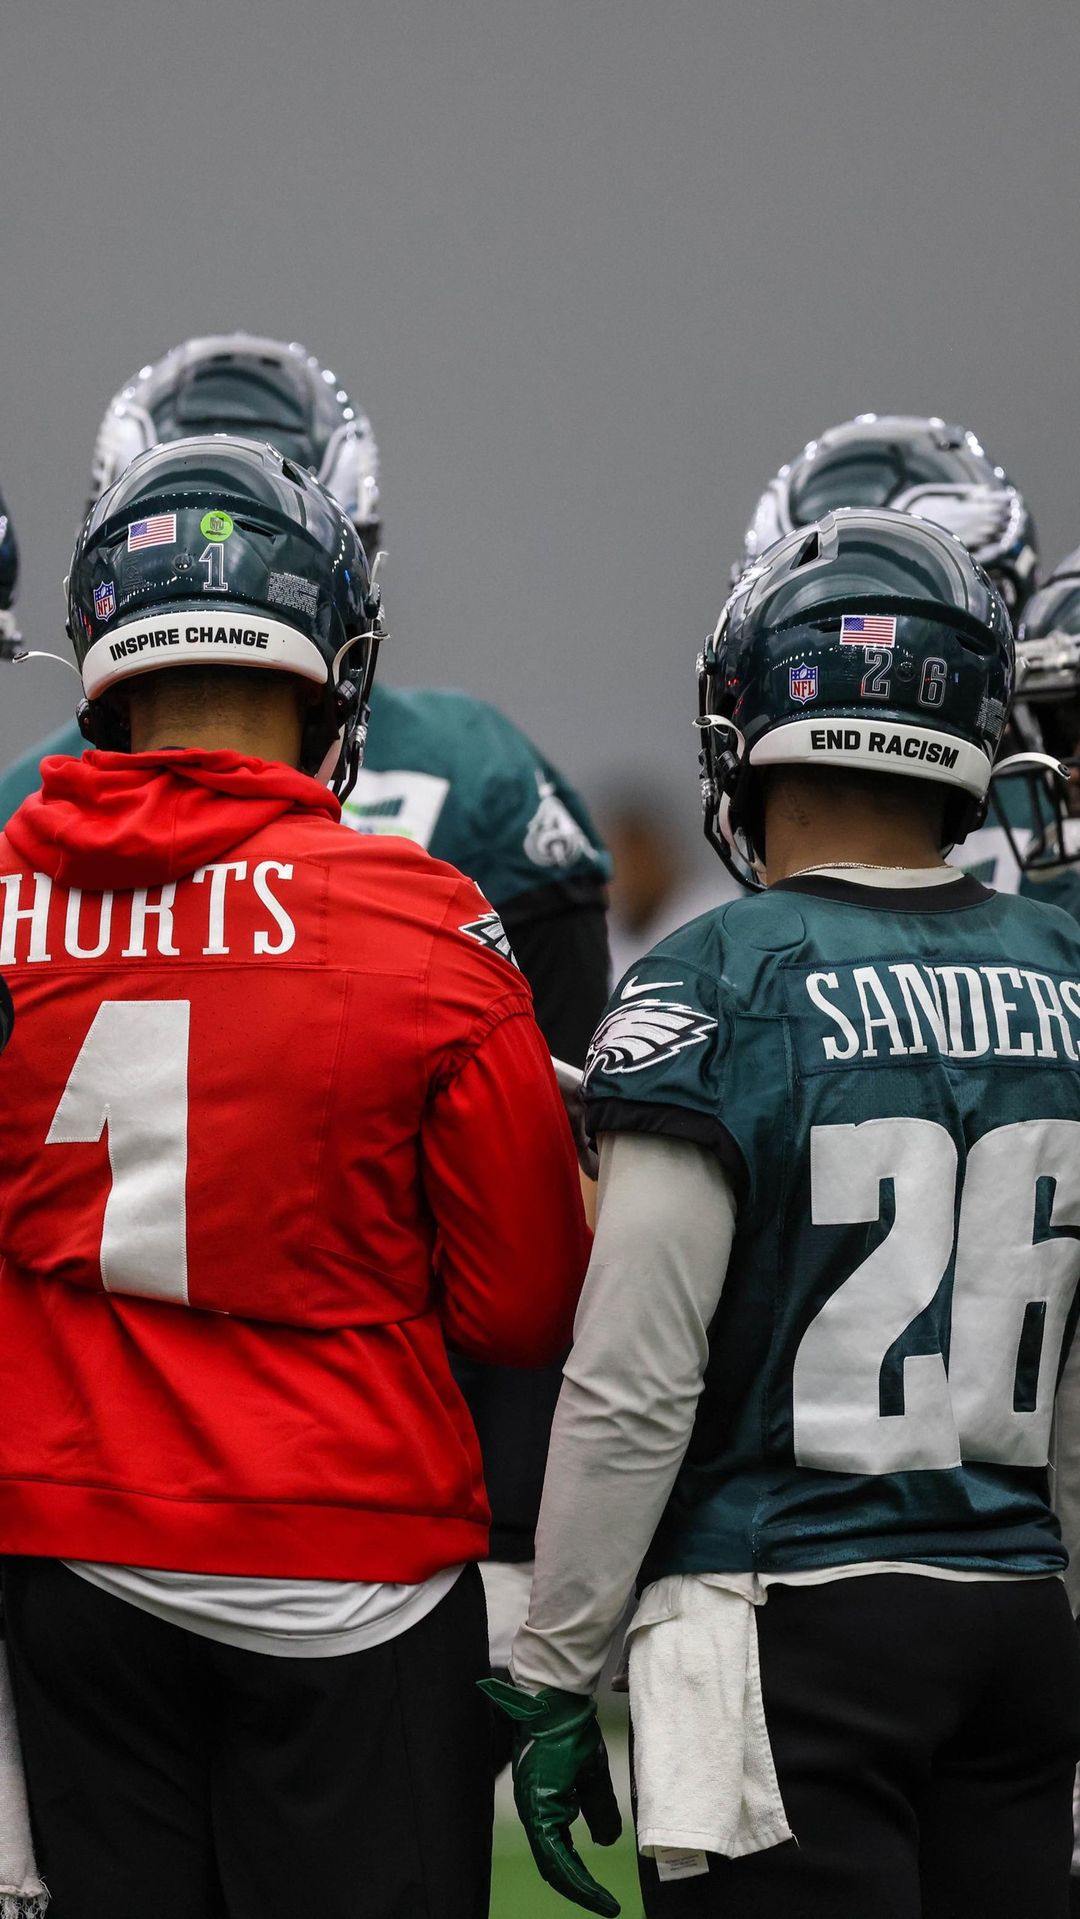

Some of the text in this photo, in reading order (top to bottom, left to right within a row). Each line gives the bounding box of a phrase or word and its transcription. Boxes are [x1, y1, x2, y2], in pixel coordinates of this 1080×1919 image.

[198, 542, 229, 593] 1
[96, 597, 114, 616] NFL
[109, 626, 270, 661] INSPIRE CHANGE
[793, 680, 815, 698] NFL
[810, 729, 960, 769] END RACISM
[0, 860, 297, 965] HURTS
[44, 999, 191, 1306] 1
[792, 1116, 1080, 1476] 26
